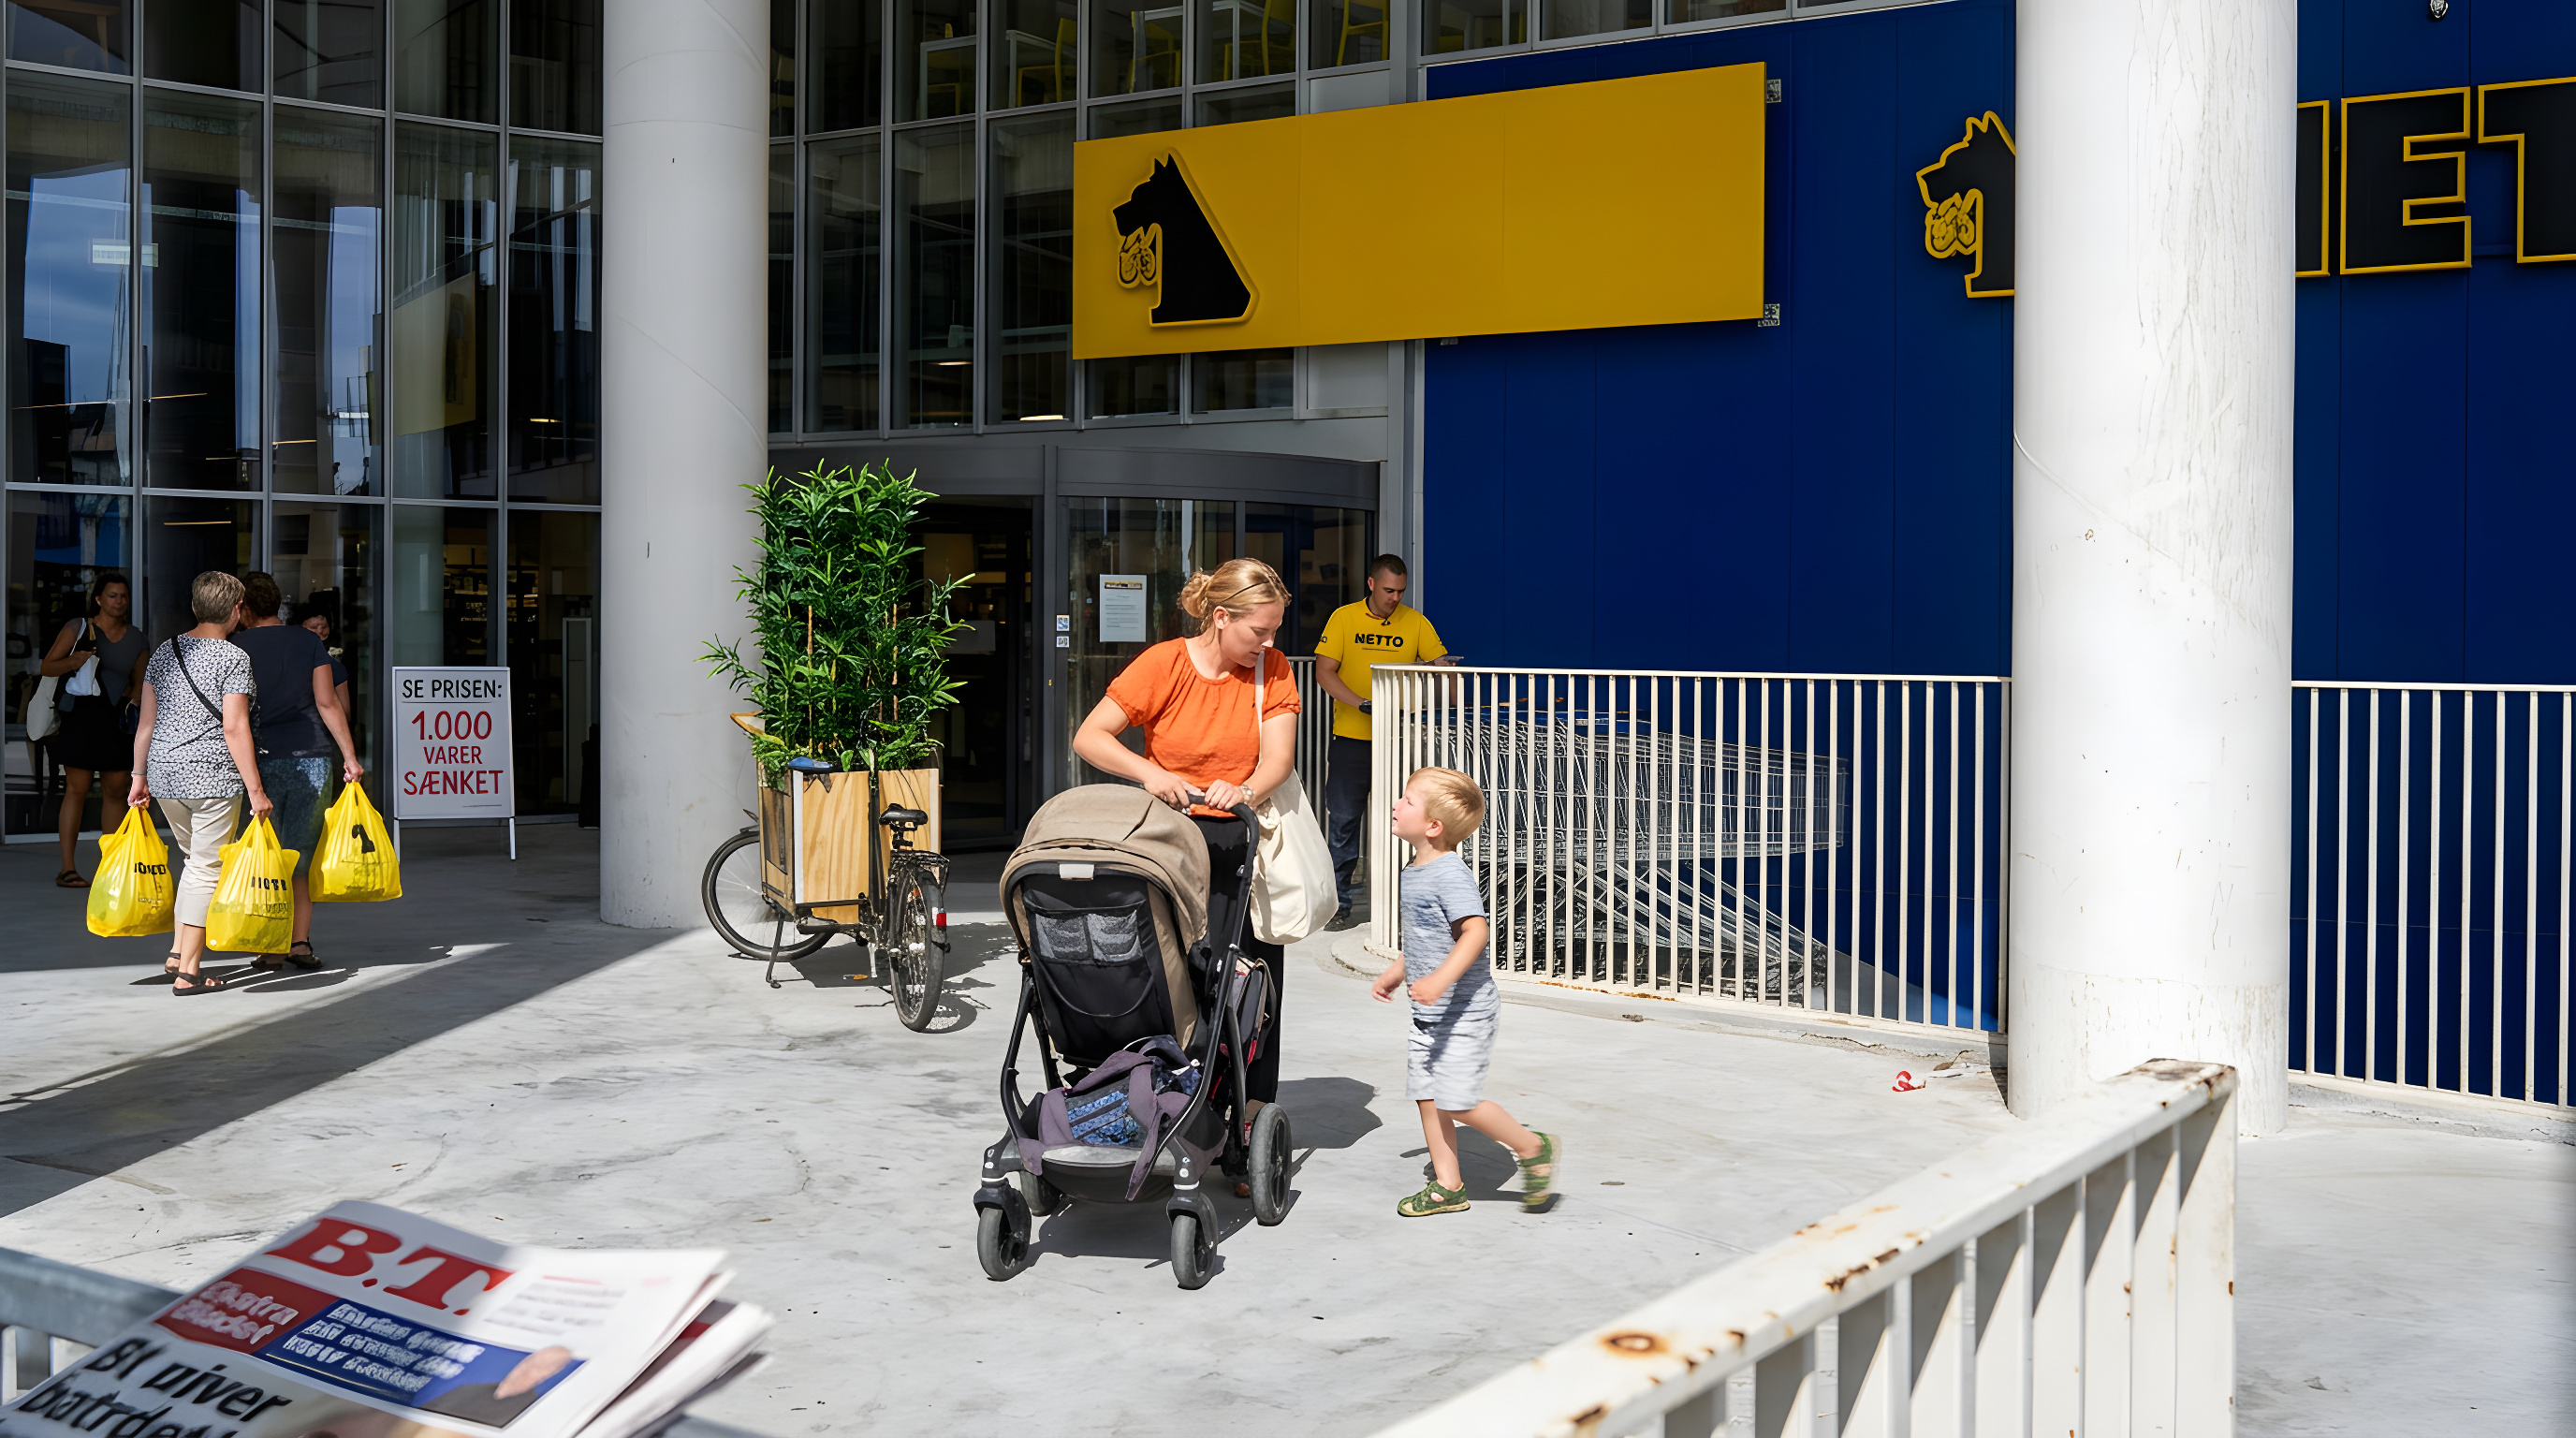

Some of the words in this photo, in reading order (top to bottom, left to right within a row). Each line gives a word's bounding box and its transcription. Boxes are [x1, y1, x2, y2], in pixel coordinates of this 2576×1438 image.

[2296, 76, 2576, 277] ET
[1354, 633, 1404, 648] NETTO
[402, 680, 424, 698] SE
[432, 680, 503, 698] PRISEN:
[412, 711, 492, 740] 1.000
[423, 746, 483, 765] VARER
[403, 770, 504, 795] SÆNKET
[262, 1217, 516, 1315] B.T.
